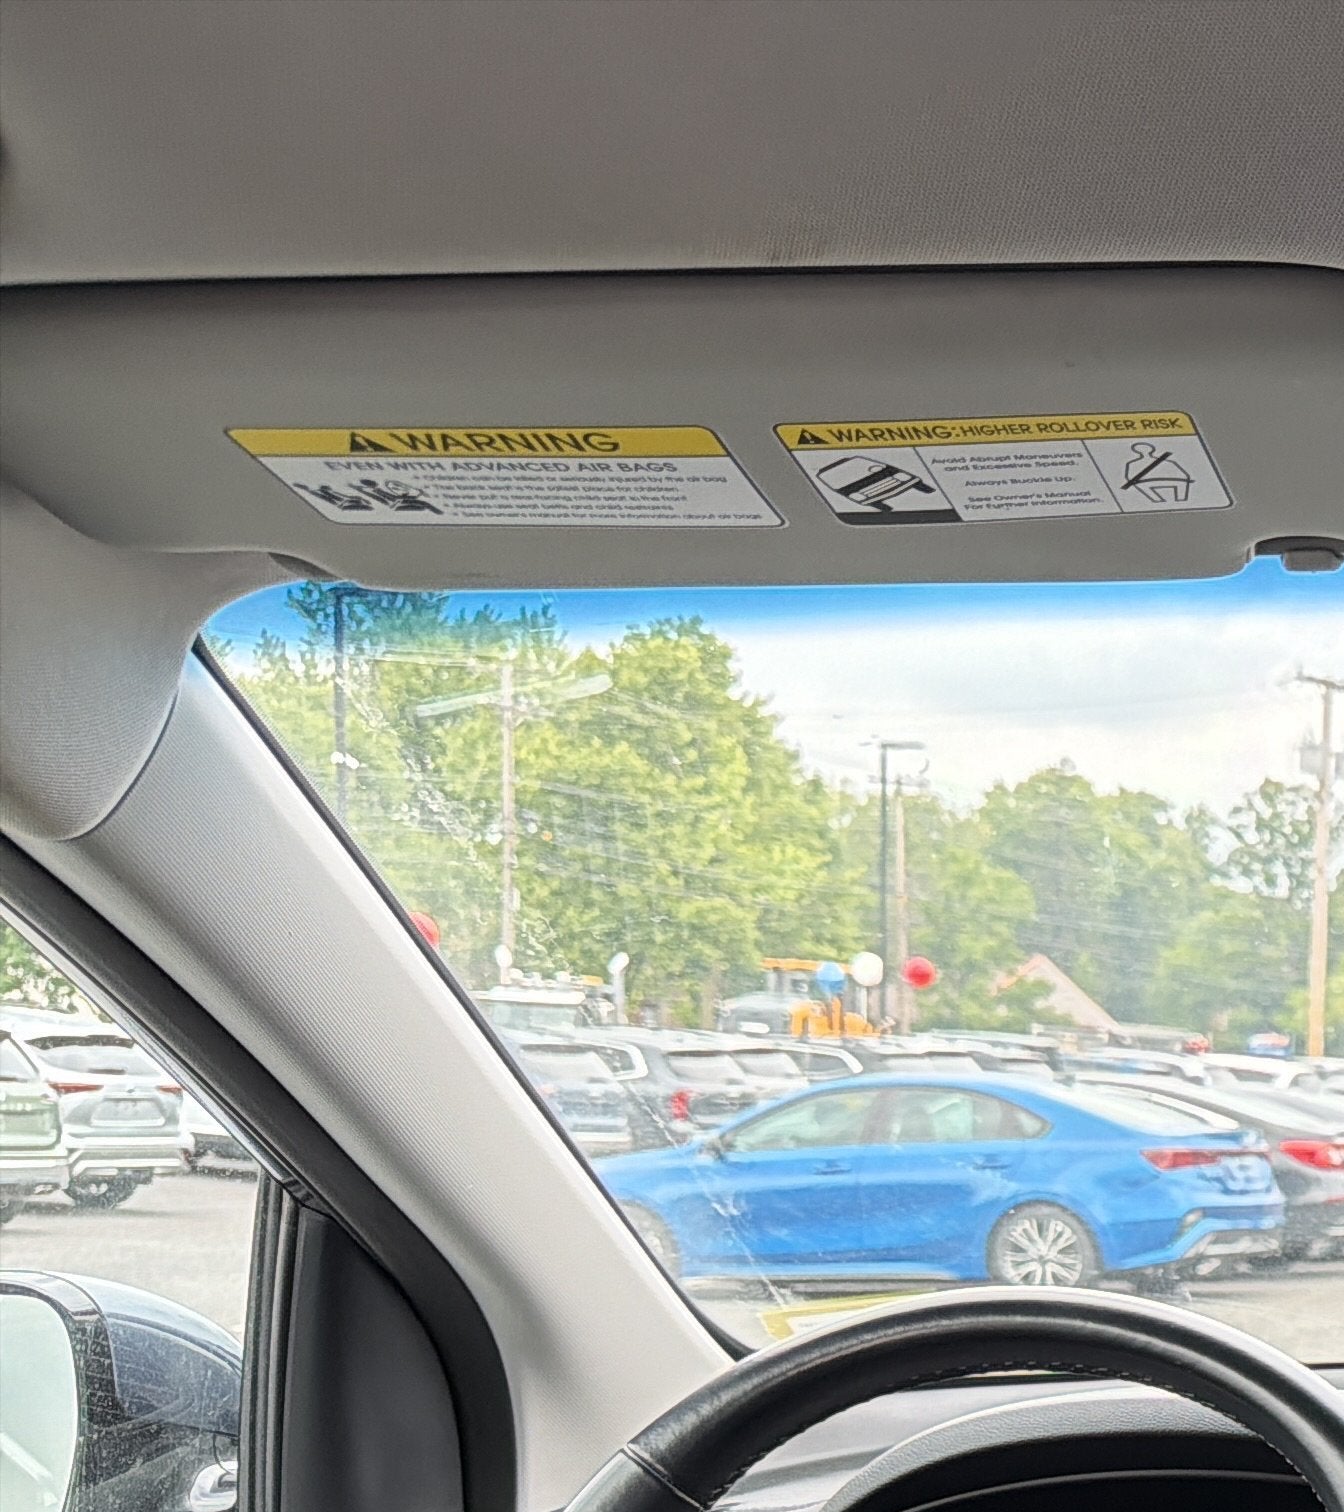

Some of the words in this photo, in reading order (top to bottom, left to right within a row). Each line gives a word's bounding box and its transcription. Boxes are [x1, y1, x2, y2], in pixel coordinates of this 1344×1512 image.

[960, 421, 1032, 437] HIGHER
[1036, 420, 1135, 433] ROLLOVER
[1140, 417, 1184, 430] RISK
[389, 432, 620, 453] WARNING
[323, 461, 384, 471] EVEN
[387, 461, 445, 471] WITH
[452, 461, 570, 472] ADVANCED
[578, 462, 612, 472] AIR
[617, 462, 678, 472] BAGS
